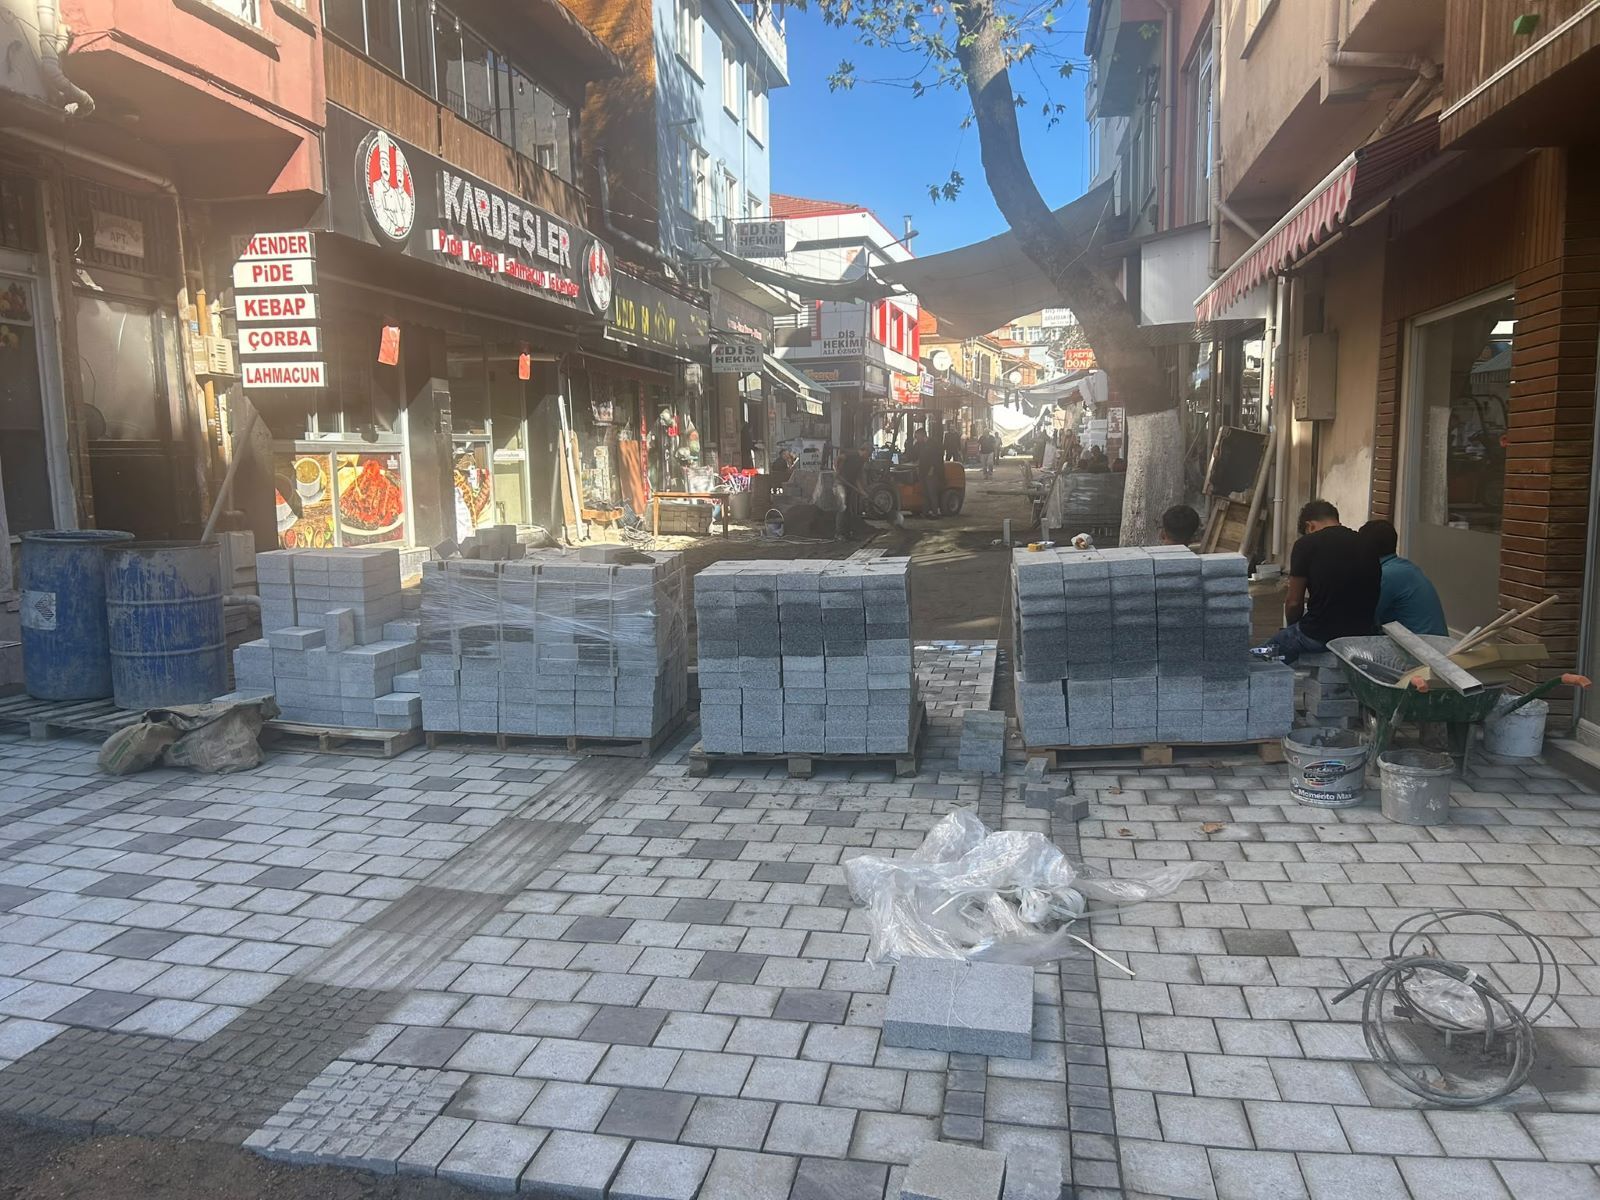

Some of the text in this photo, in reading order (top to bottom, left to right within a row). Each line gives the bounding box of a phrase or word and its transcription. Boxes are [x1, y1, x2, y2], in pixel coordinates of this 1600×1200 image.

[244, 298, 306, 317] KEBAP
[248, 330, 312, 351] ÇORBA
[246, 367, 320, 384] LAHMACUN
[1298, 788, 1353, 800] Momento Max
